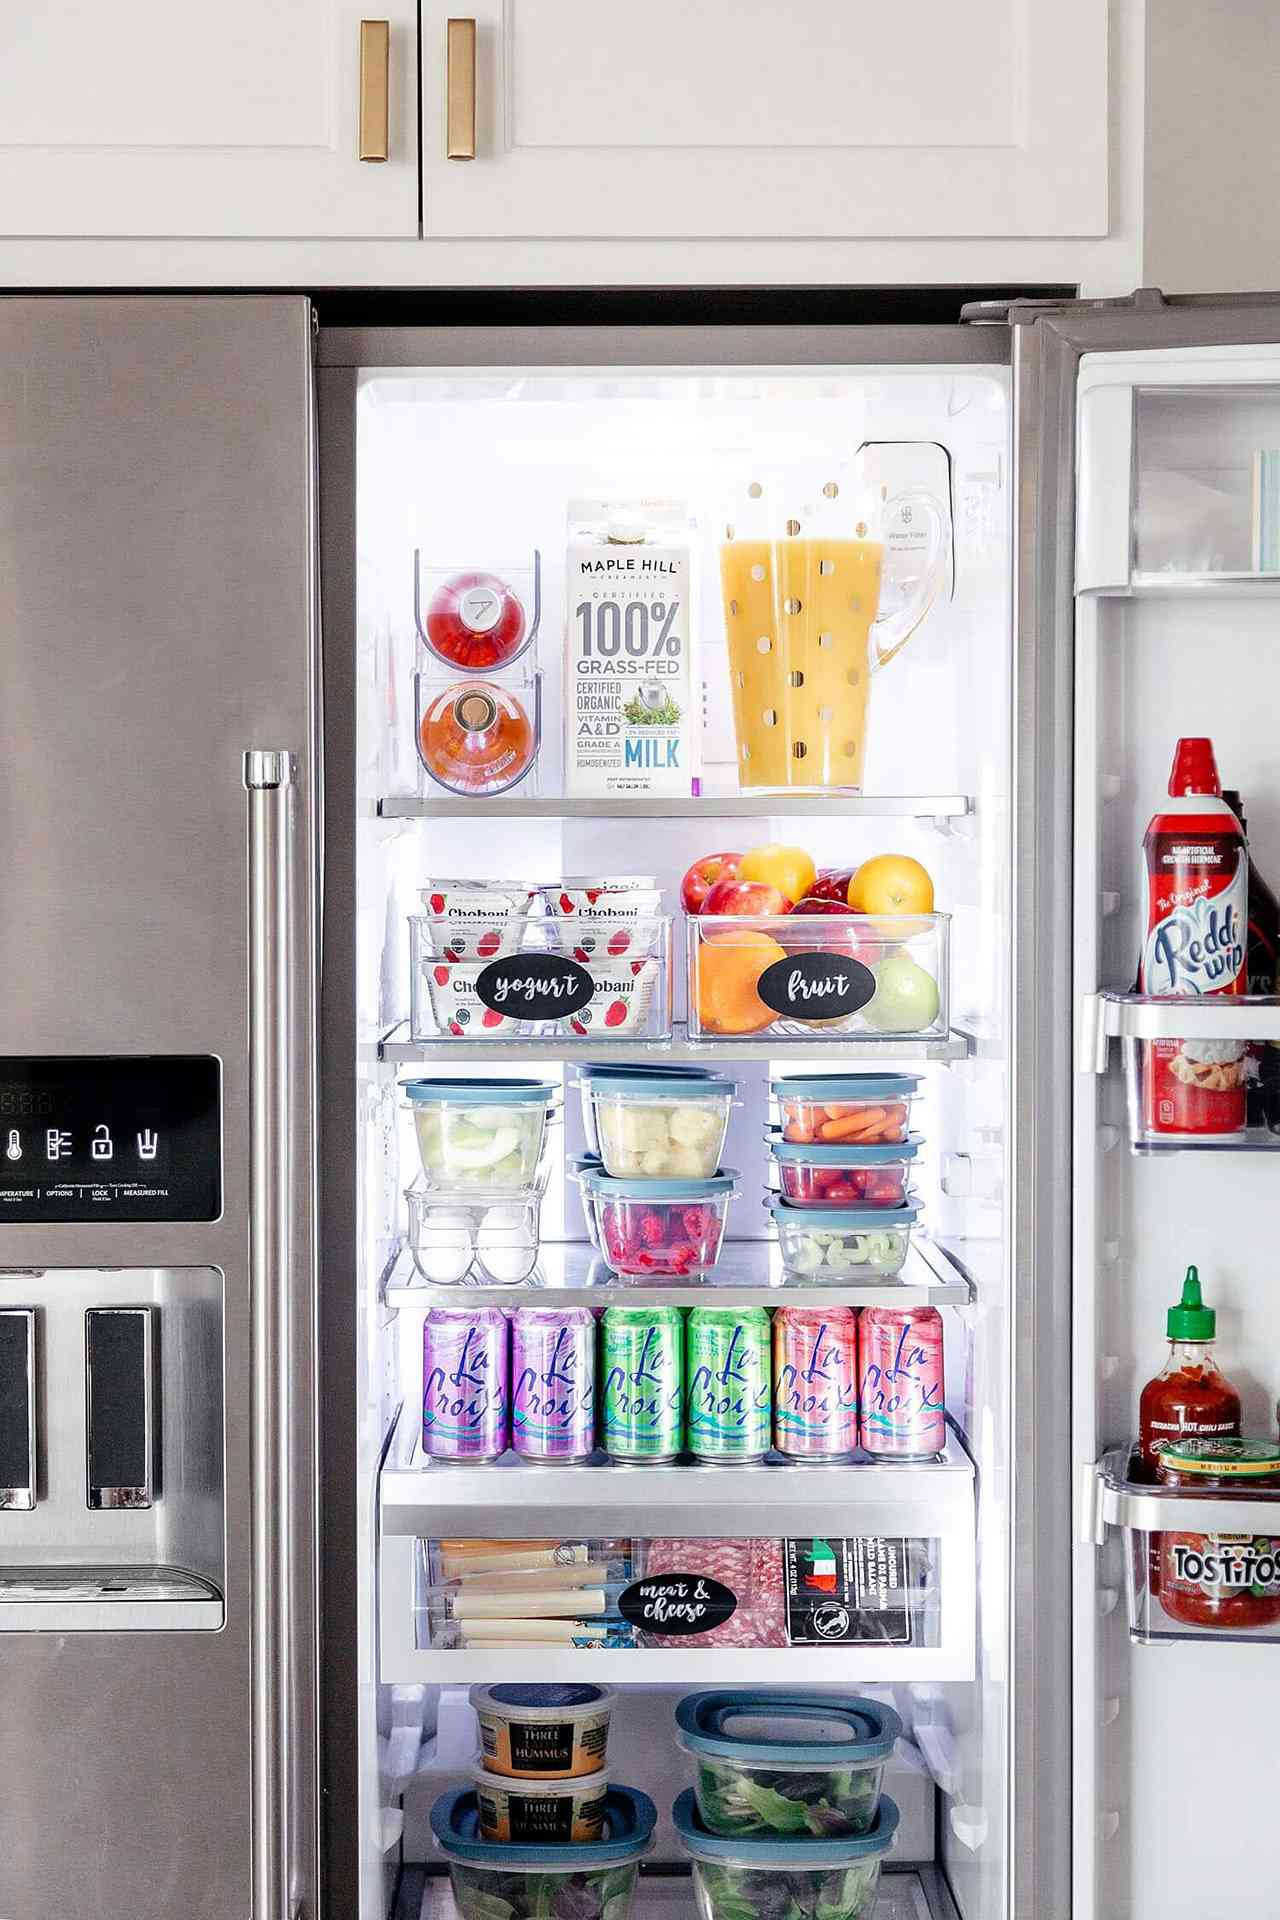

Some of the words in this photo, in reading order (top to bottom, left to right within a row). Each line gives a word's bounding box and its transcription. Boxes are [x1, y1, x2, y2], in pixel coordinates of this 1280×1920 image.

[581, 559, 635, 574] MAPLE
[642, 559, 677, 574] HILL
[576, 601, 681, 657] 100%
[577, 660, 680, 675] GRASS-FED
[577, 682, 622, 695] CERTIFIED
[577, 695, 622, 710] ORGANIC
[625, 739, 680, 768] MILK
[1155, 904, 1238, 988] Reddi
[1204, 944, 1242, 979] wip
[494, 975, 580, 1002] yogurt
[594, 979, 635, 993] obani
[788, 969, 850, 1002] fruit
[123, 1189, 156, 1197] MEASURED
[450, 1327, 488, 1387] La
[541, 1327, 578, 1387] La
[629, 1327, 668, 1386] La
[716, 1325, 757, 1385] La
[801, 1324, 845, 1383] La
[885, 1324, 928, 1383] La
[1183, 1422, 1198, 1432] HOT
[888, 1546, 898, 1589] UNCURED
[640, 1582, 689, 1599] meat
[693, 1579, 711, 1600] &
[644, 1597, 706, 1623] cheese
[523, 1730, 559, 1740] THREE
[515, 1747, 569, 1760] HUMMUS
